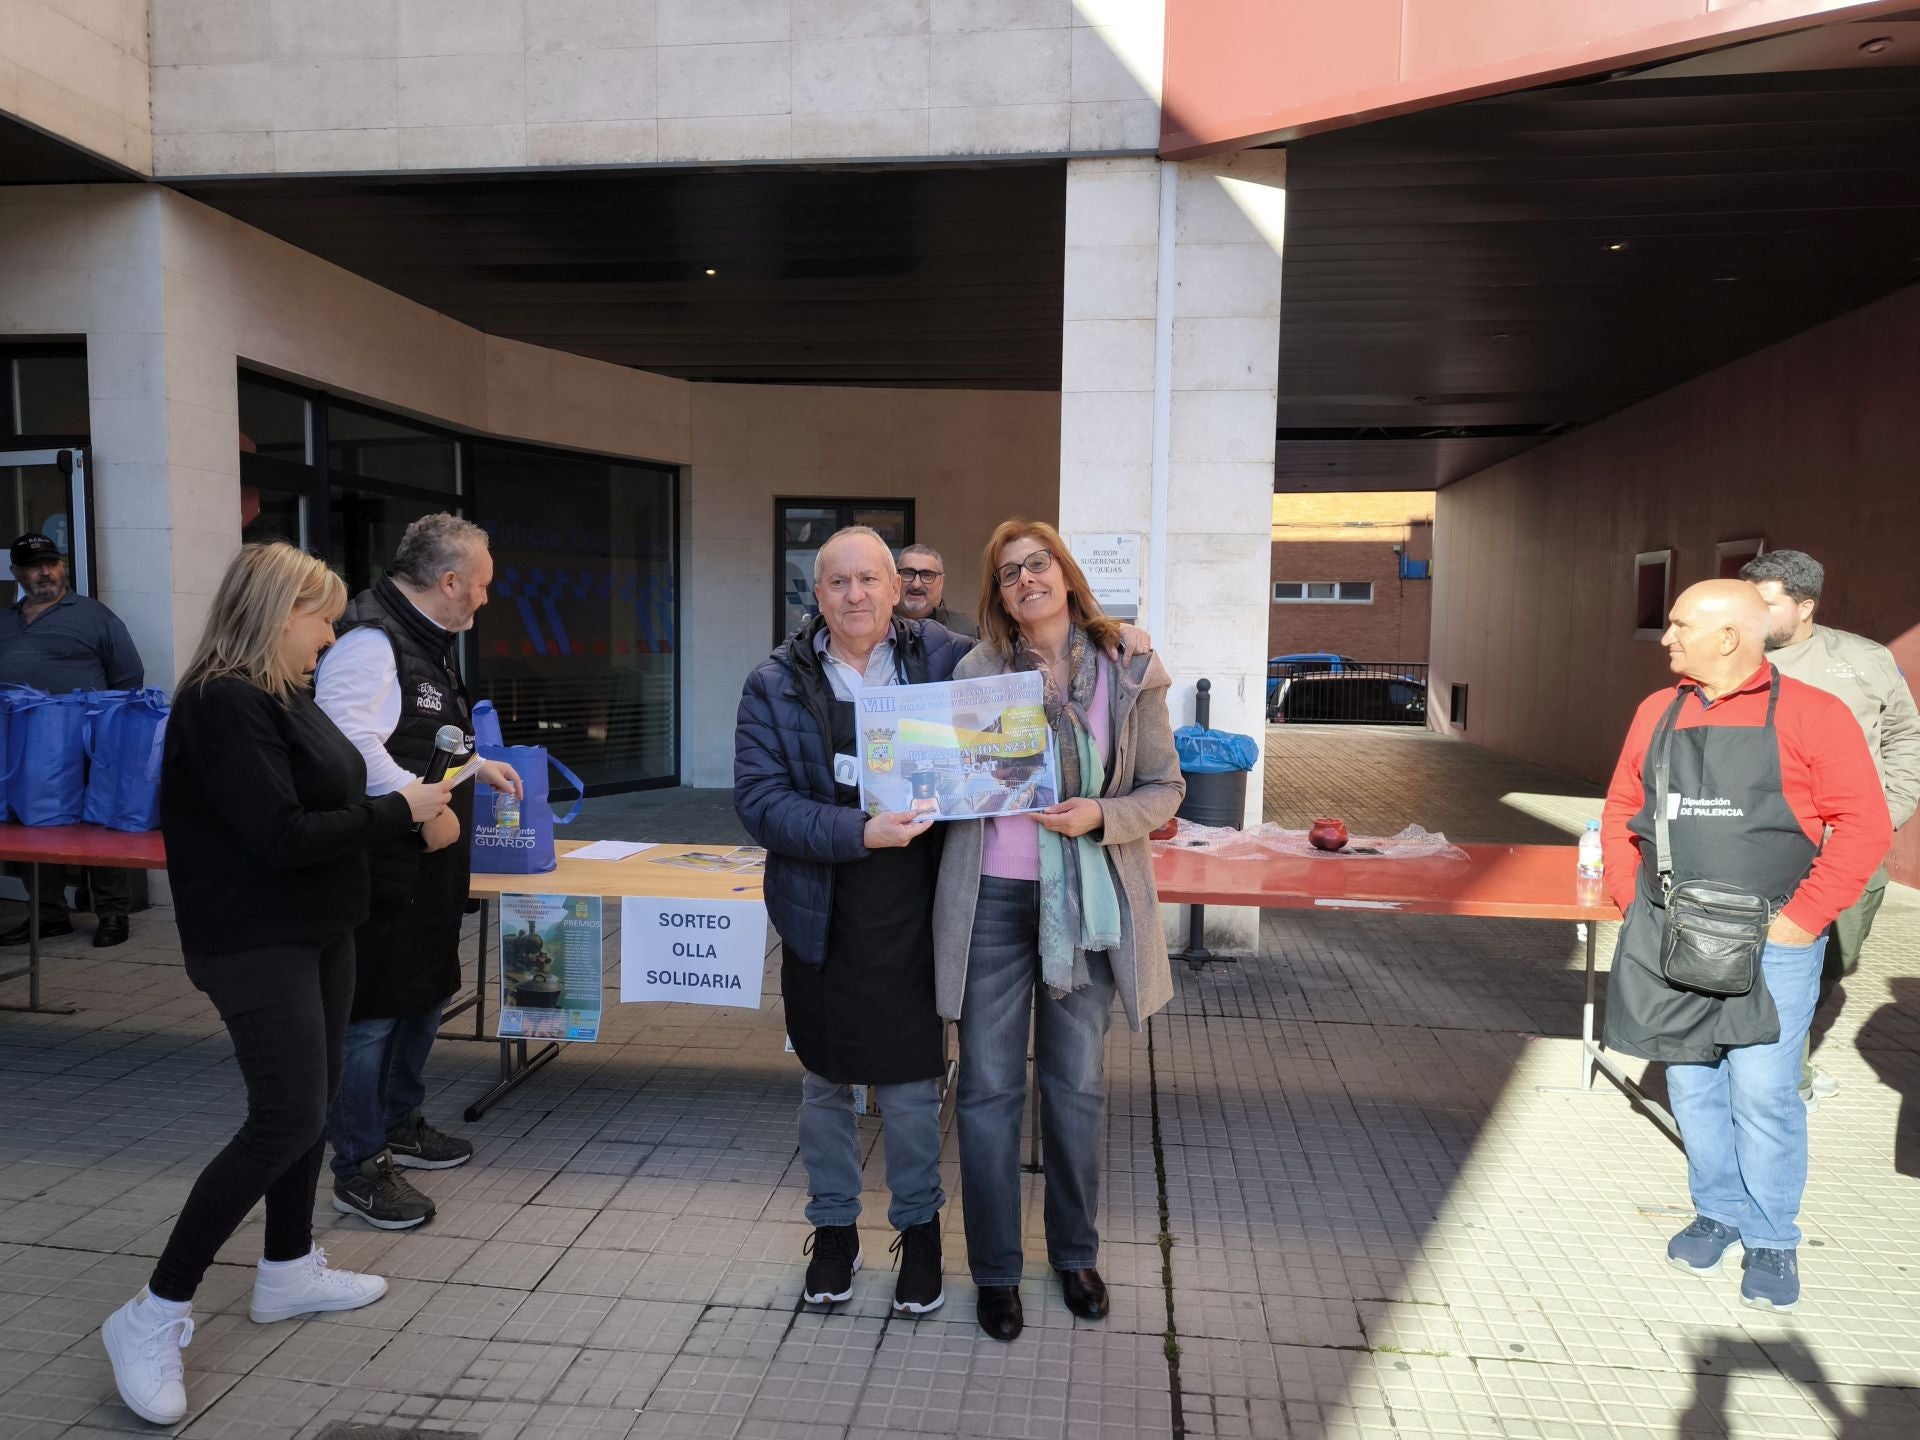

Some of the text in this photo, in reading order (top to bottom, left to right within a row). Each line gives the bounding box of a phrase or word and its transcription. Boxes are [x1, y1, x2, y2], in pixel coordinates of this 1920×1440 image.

[1094, 566, 1123, 574] QUEJAS
[416, 696, 442, 711] ROAD
[863, 697, 896, 713] VIII
[1004, 740, 1027, 751] 823
[1682, 797, 1731, 807] Diputación
[1680, 808, 1744, 817] DE PALENCIA
[475, 837, 536, 849] GUARDO
[563, 920, 600, 928] PREMIOS
[658, 912, 731, 930] SORTEO
[672, 942, 718, 959] OLLA
[646, 970, 742, 990] SOLIDARIA
